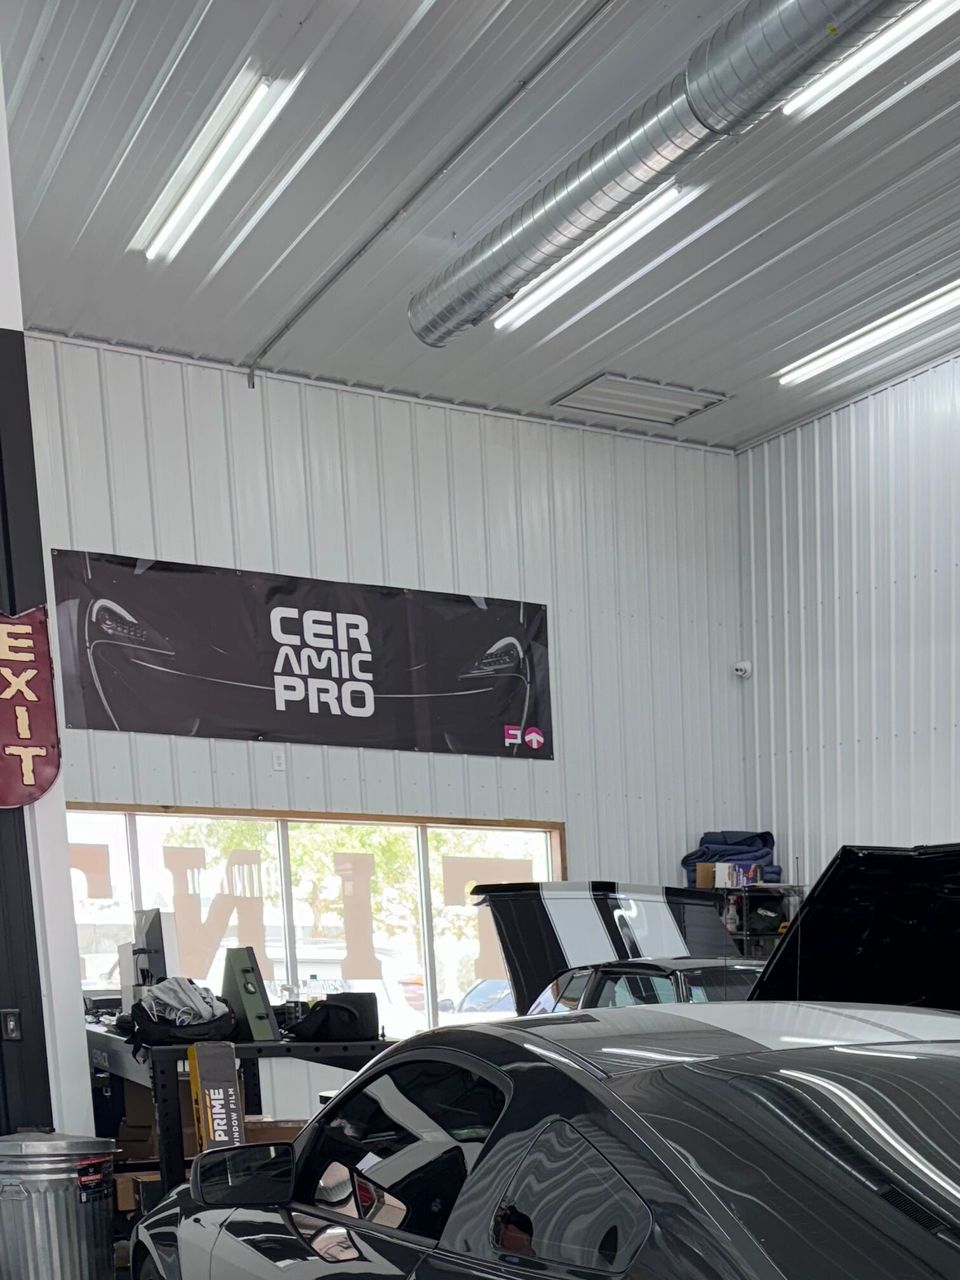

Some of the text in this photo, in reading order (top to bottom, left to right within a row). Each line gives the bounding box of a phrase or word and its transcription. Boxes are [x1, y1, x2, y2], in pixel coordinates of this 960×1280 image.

[270, 606, 371, 652] CER
[273, 645, 373, 680] AMIC
[0, 623, 47, 785] EXIT
[273, 675, 375, 718] PRO
[209, 1088, 229, 1141] PRIME
[228, 1087, 237, 1109] FILM
